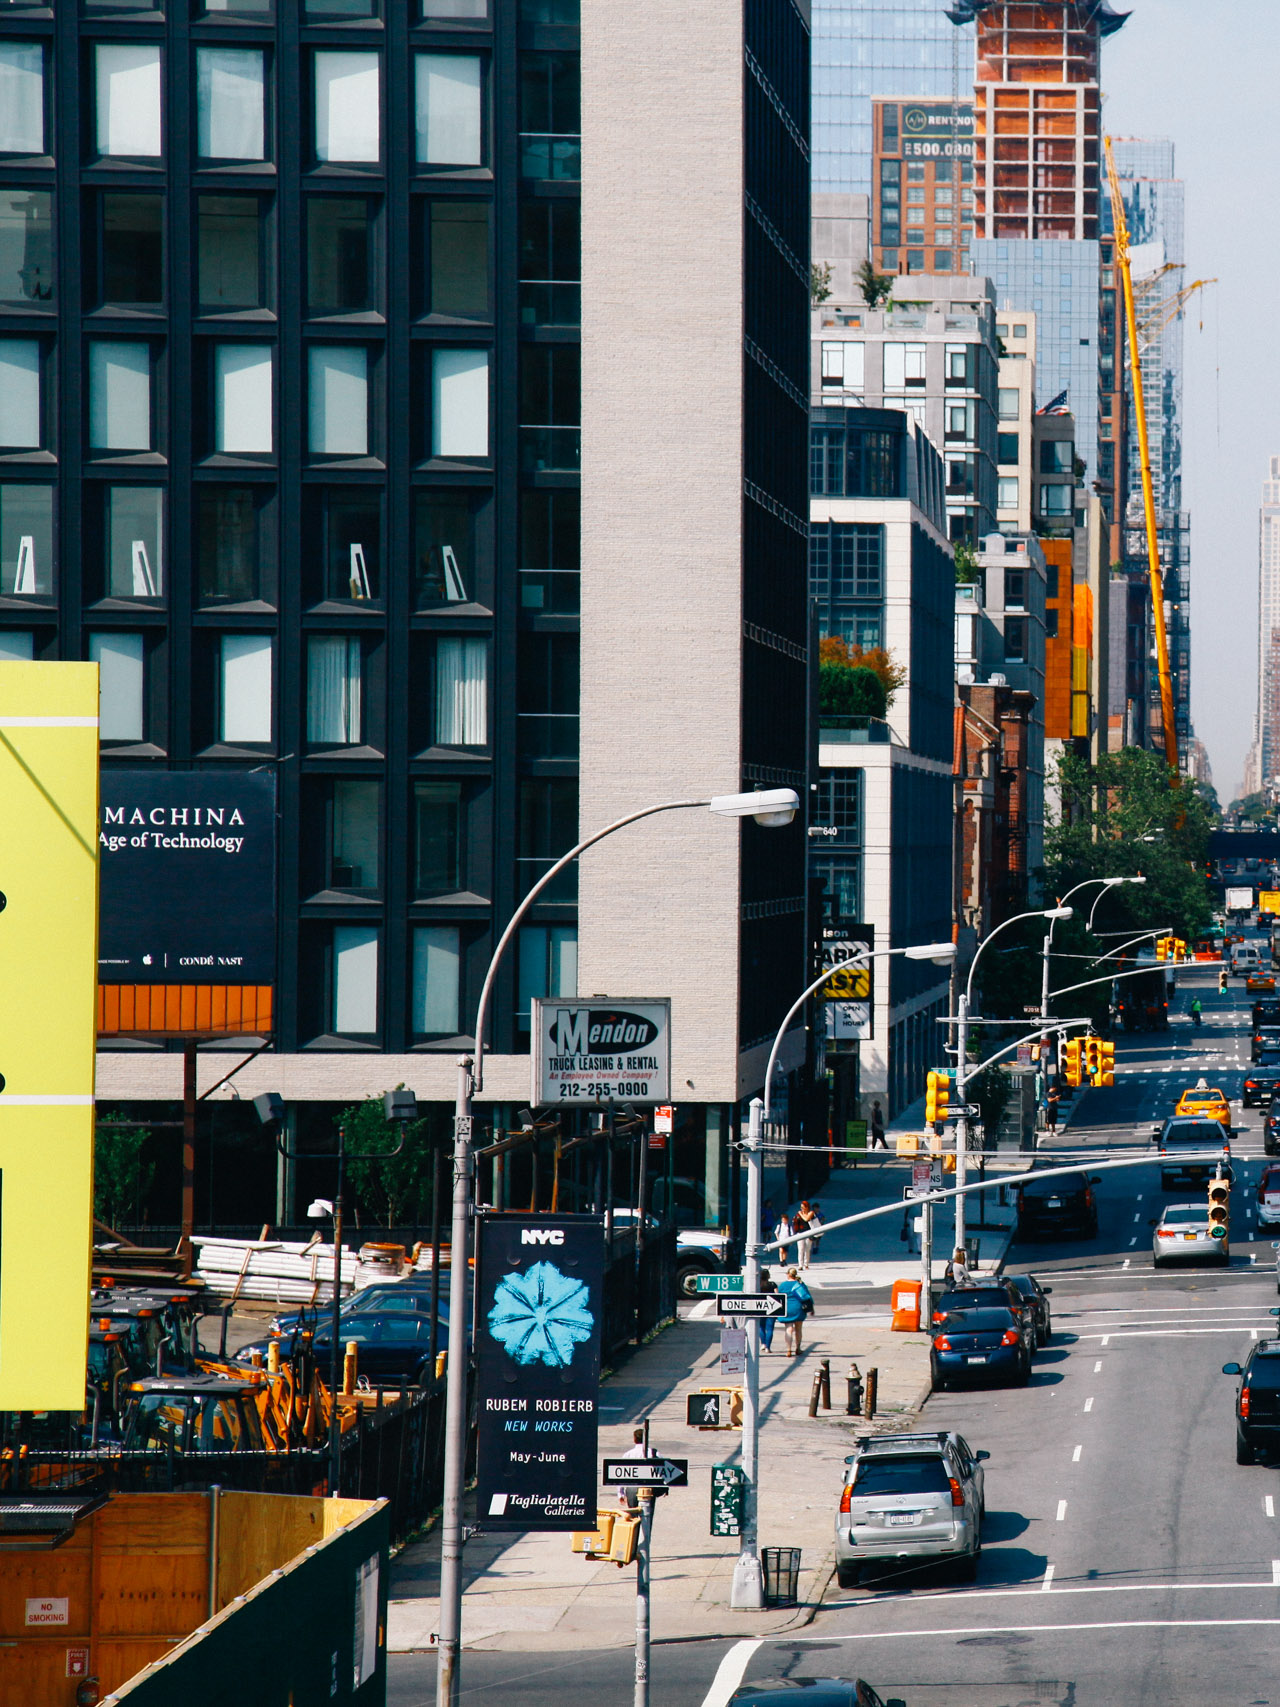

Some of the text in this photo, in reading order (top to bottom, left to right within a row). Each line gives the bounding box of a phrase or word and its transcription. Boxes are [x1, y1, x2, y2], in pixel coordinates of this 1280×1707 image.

[928, 115, 954, 125] RENT
[104, 806, 245, 826] MACHINA
[823, 827, 838, 836] 640
[99, 831, 244, 853] Age of Technology
[823, 928, 848, 938] ison
[179, 955, 243, 966] CONDÉ NAST
[822, 949, 863, 965] ARK
[823, 974, 862, 991] AST
[556, 1009, 649, 1056] Mendon
[549, 1056, 659, 1071] TRUCK LEASING & RENTAL
[549, 1072, 559, 1080] An
[561, 1072, 594, 1080] Employee
[596, 1071, 619, 1079] Owned
[621, 1071, 653, 1080] Company
[560, 1082, 648, 1097] 212-255-0900
[521, 1229, 565, 1246] NYC
[700, 1277, 710, 1290] W
[716, 1277, 729, 1290] 18
[727, 1300, 775, 1310] ONE WAY
[486, 1398, 593, 1412] RUBEM ROBIERB
[504, 1420, 574, 1432] NEW WORKS
[510, 1451, 566, 1463] May-June
[615, 1467, 675, 1478] ONE WAY
[509, 1494, 585, 1509] Taglialatella
[544, 1505, 585, 1516] Galleries
[41, 1603, 53, 1611] NO
[28, 1613, 65, 1622] SMOKING
